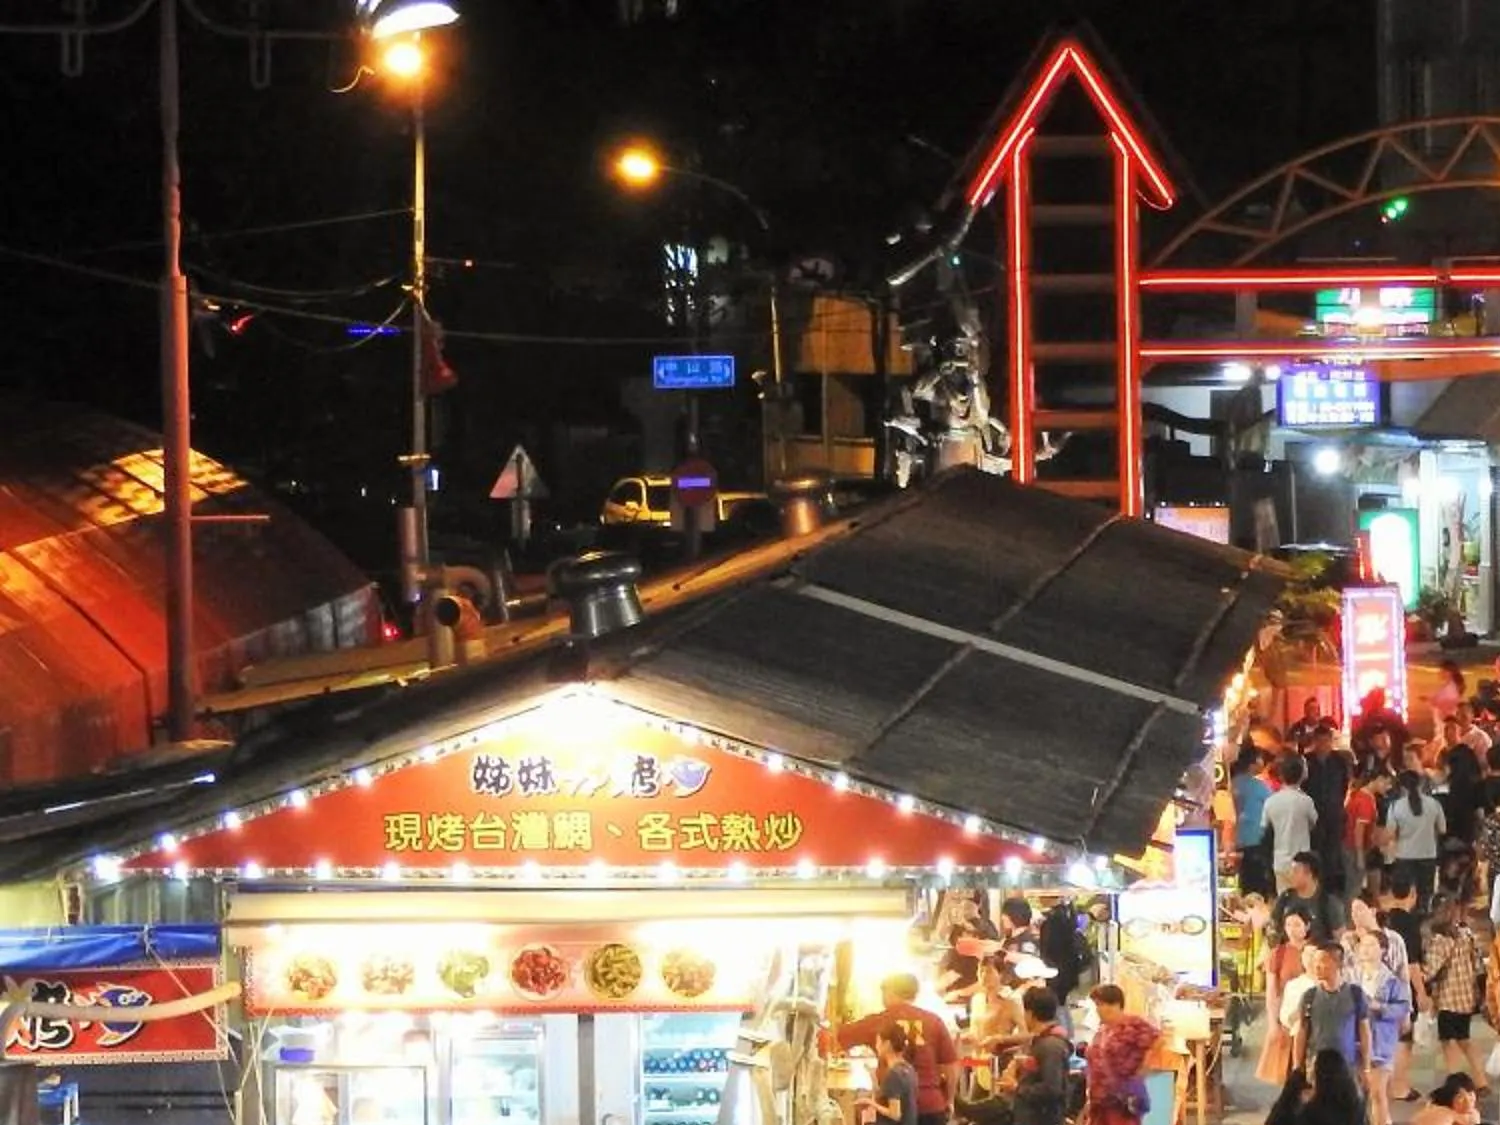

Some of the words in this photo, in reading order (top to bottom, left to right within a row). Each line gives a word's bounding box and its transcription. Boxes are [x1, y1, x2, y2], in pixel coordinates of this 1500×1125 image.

[385, 811, 803, 851] 現烤台灣鯛、各式熱炒
